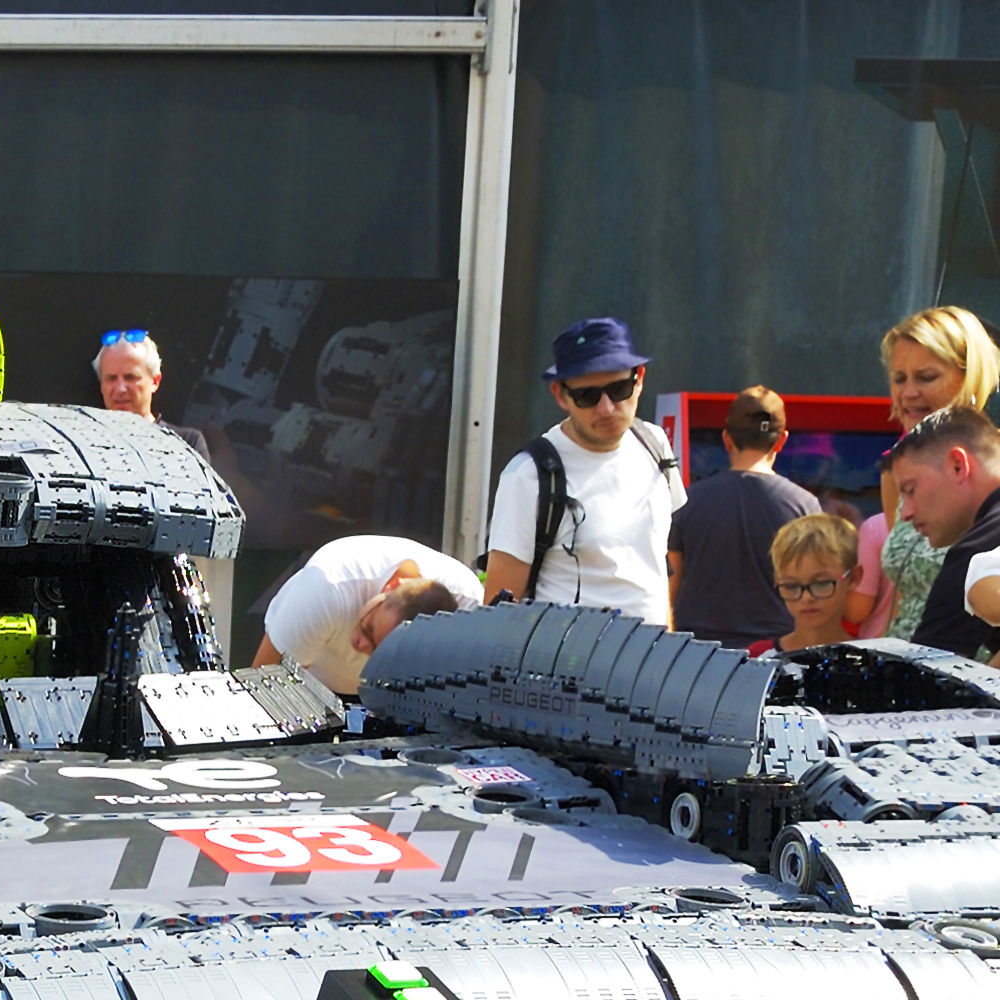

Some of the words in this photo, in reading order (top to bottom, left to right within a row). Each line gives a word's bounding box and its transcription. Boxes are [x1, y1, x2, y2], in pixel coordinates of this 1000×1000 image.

[489, 685, 576, 715] PEUGEOT
[824, 711, 974, 730] Capgemini
[94, 791, 326, 805] TotalEnergies
[204, 826, 403, 868] 93
[174, 890, 597, 910] PEUGEOT
